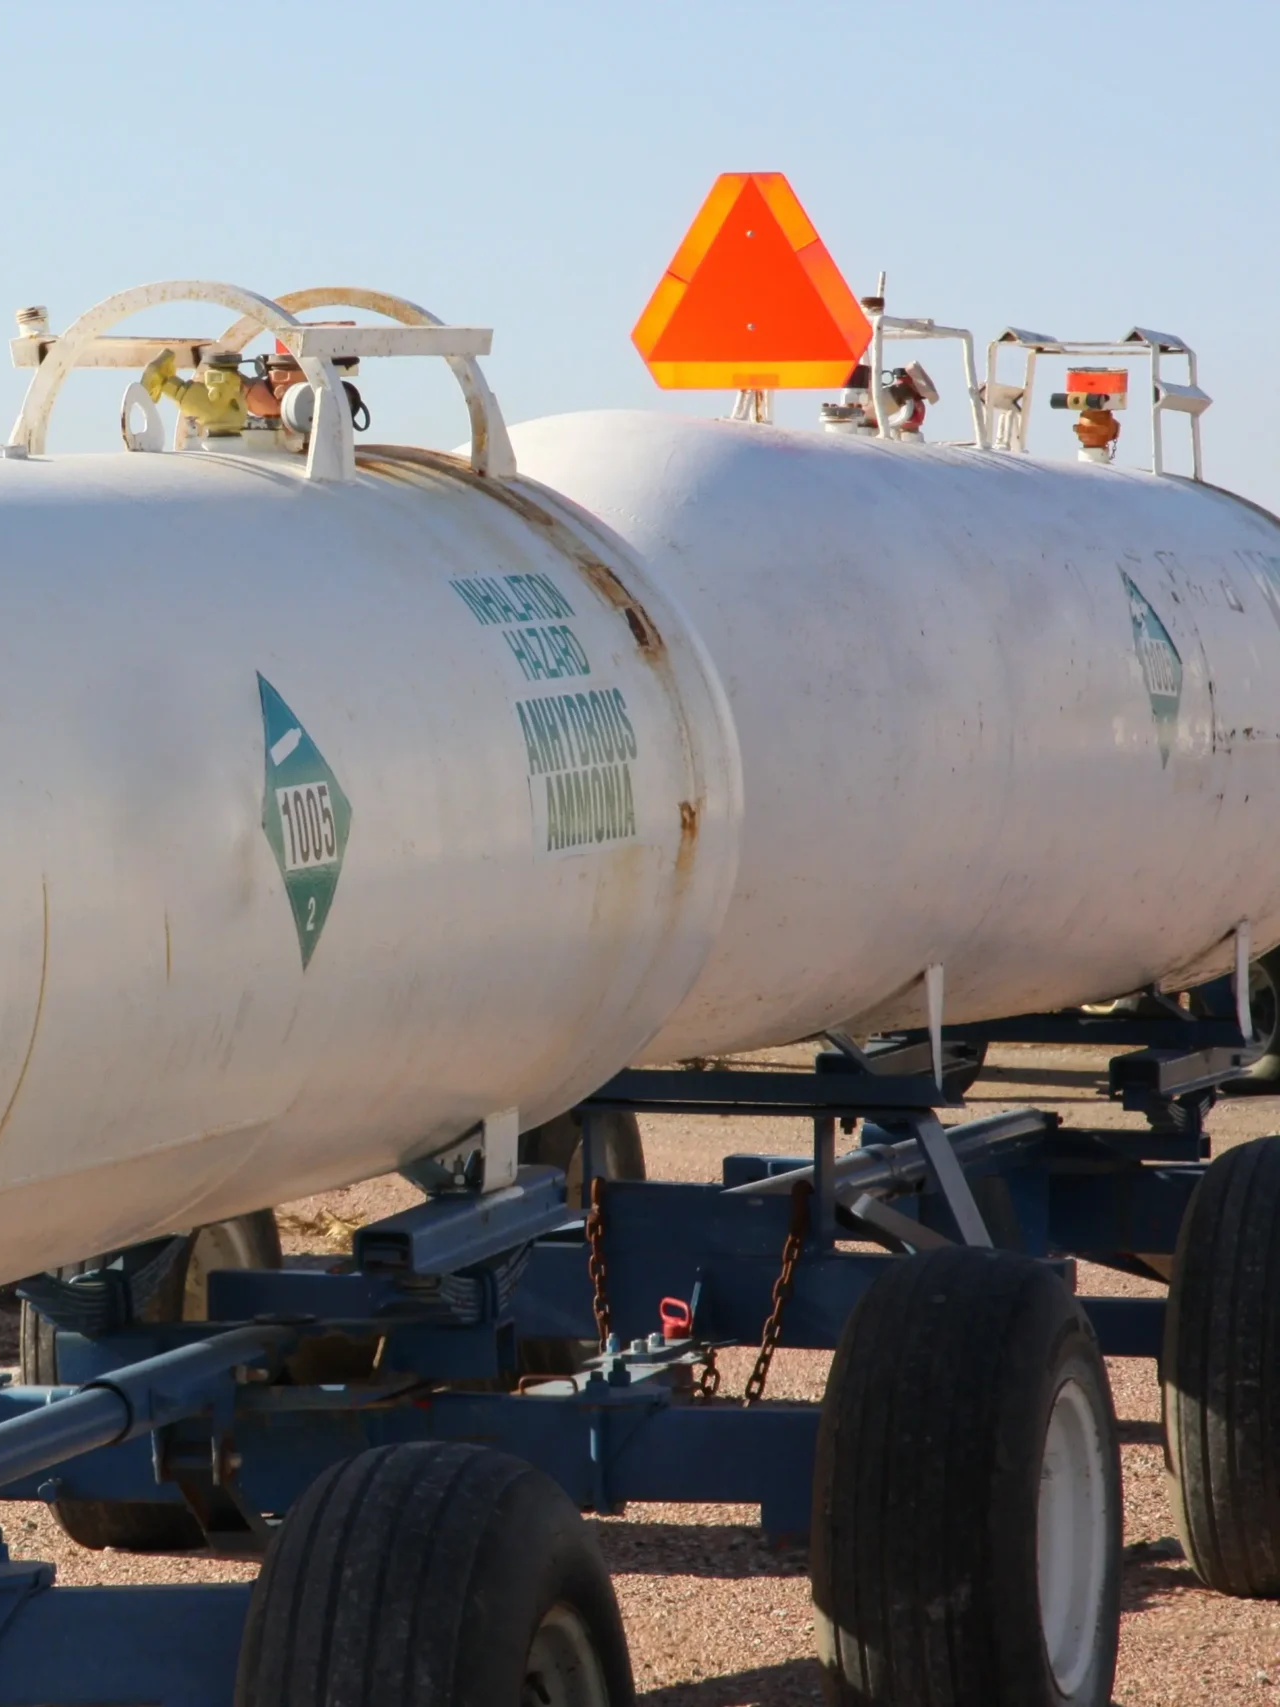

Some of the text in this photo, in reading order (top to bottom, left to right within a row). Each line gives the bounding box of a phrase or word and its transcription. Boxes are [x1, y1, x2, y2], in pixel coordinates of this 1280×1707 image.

[448, 573, 576, 625] INHALATION
[502, 625, 591, 681] HAZARD
[515, 687, 637, 775] ANHYDROUS
[282, 785, 336, 865] 1005
[545, 763, 636, 851] AMMONIA
[306, 897, 316, 931] 2
